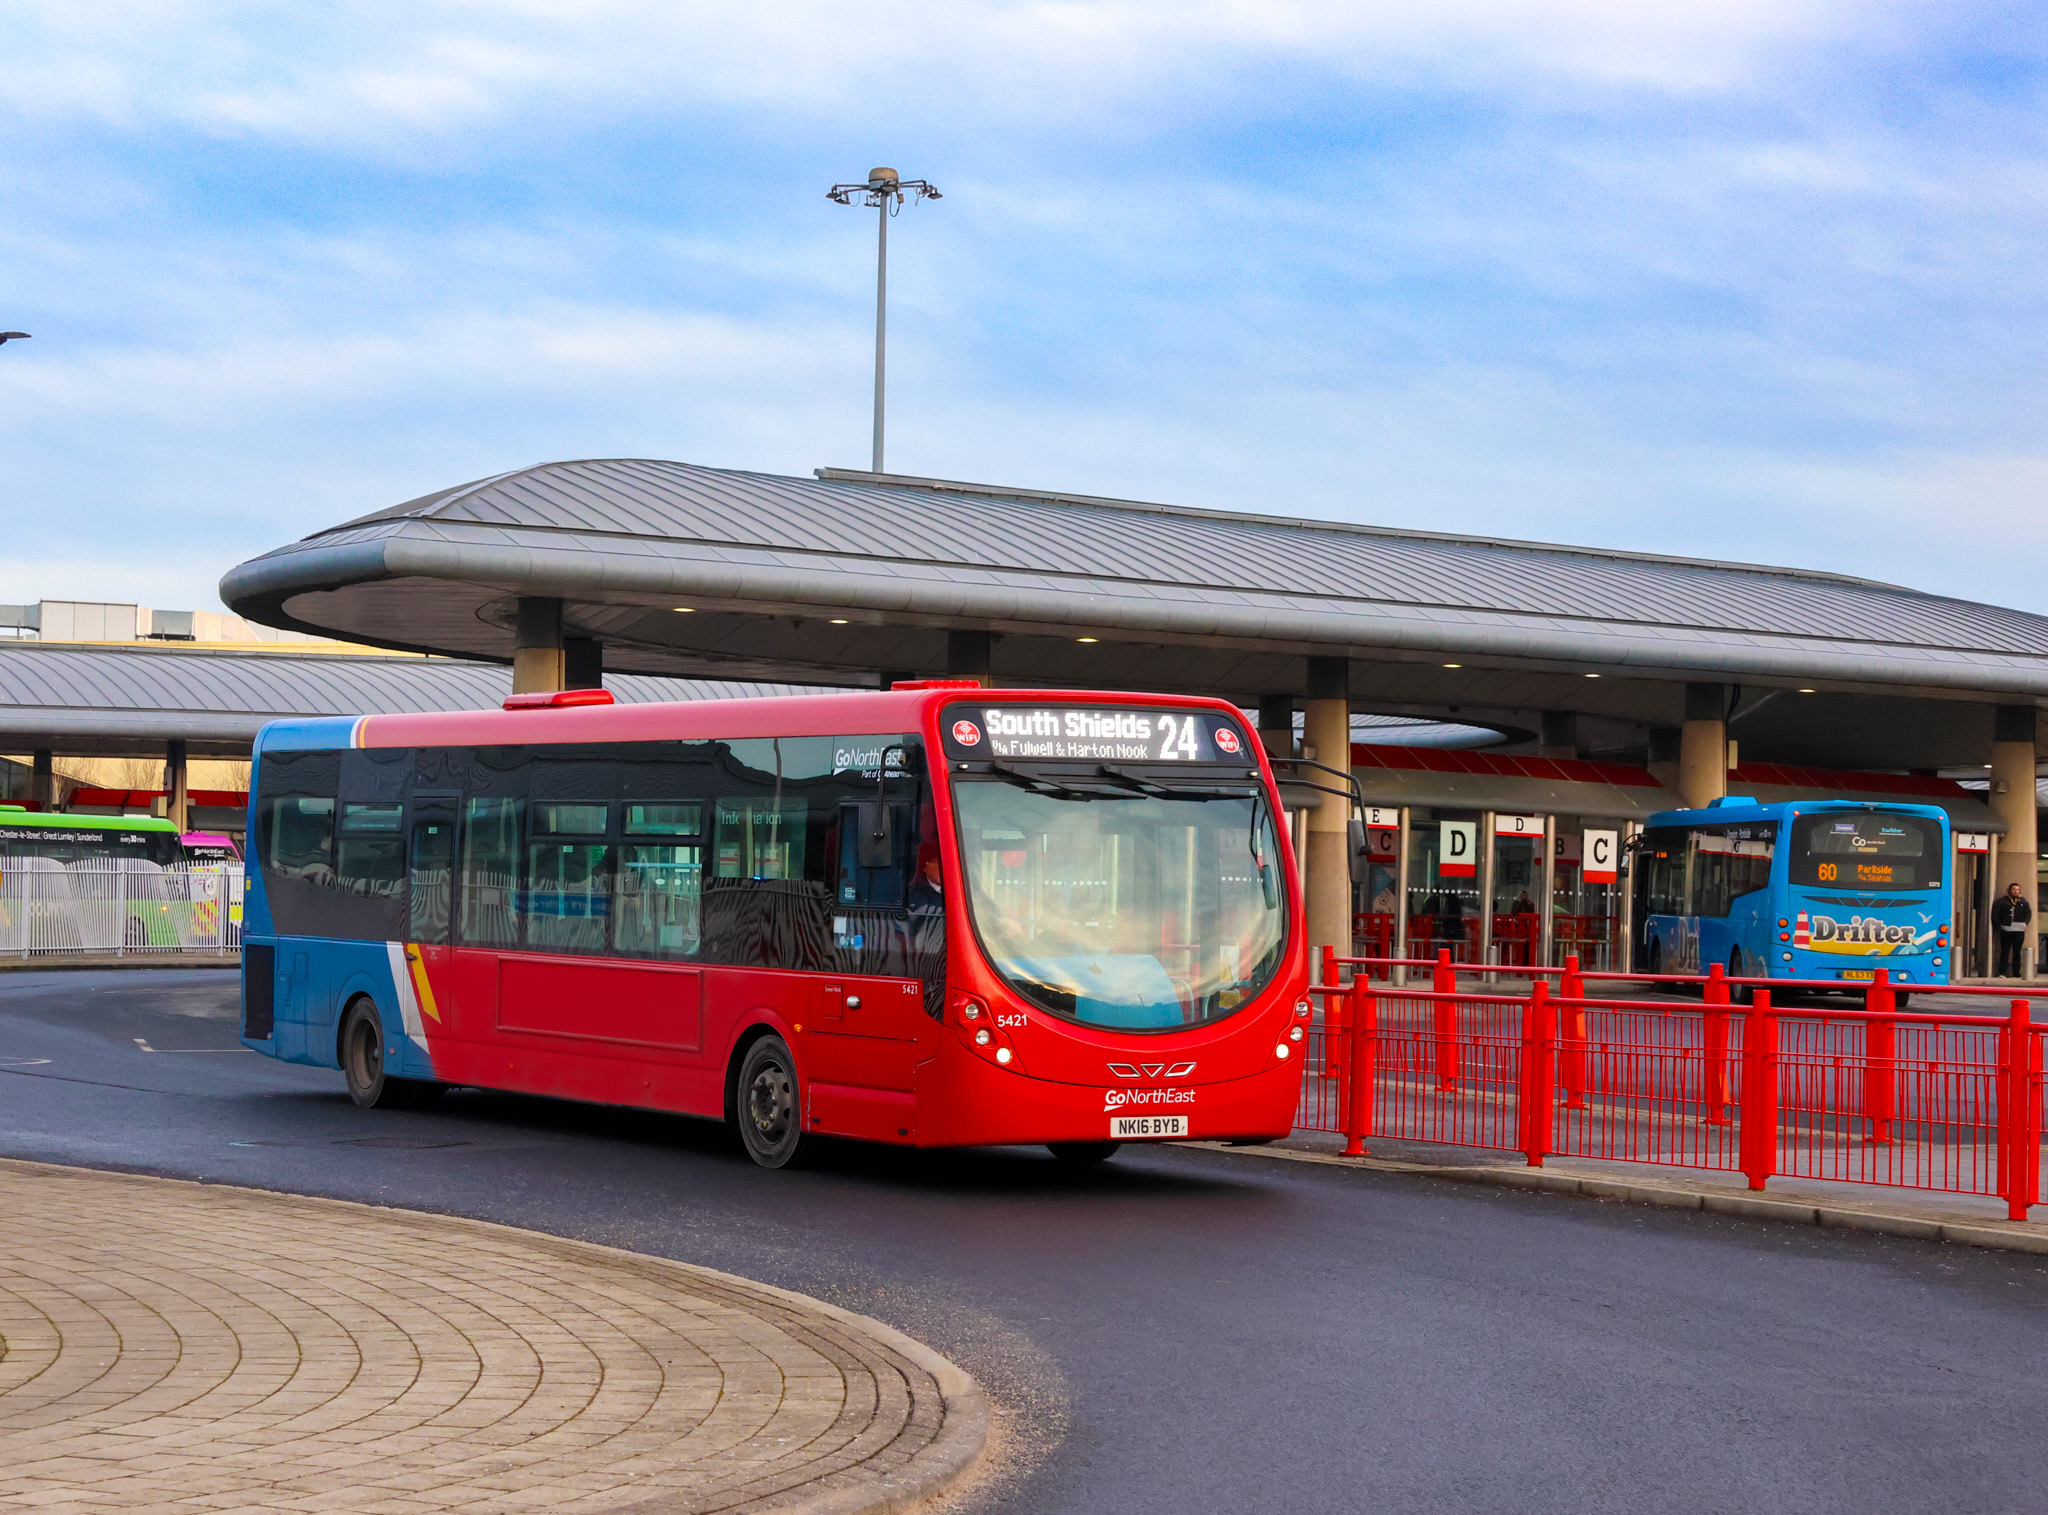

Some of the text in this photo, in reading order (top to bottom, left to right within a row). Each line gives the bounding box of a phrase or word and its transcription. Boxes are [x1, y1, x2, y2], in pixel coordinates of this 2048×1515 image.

[986, 710, 1151, 739] South Shields
[1157, 715, 1198, 760] 24
[1010, 740, 1053, 756] Fulwell
[1055, 742, 1065, 757] &
[1067, 742, 1114, 758] Harton
[1116, 744, 1149, 759] Nook
[1372, 809, 1380, 823] E
[1515, 817, 1525, 831] D
[130, 834, 137, 843] 30
[1380, 832, 1392, 851] C
[1449, 830, 1466, 856] D
[1554, 837, 1565, 855] B
[1969, 835, 1977, 848] A
[1593, 837, 1608, 864] C
[1818, 863, 1893, 881] 60 Parkside
[1812, 915, 1916, 944] Drifter
[902, 984, 918, 995] 5421
[997, 1014, 1028, 1027] 5421
[1104, 1088, 1196, 1105] GoNorthEast
[1119, 1118, 1180, 1134] NK16 BYB
